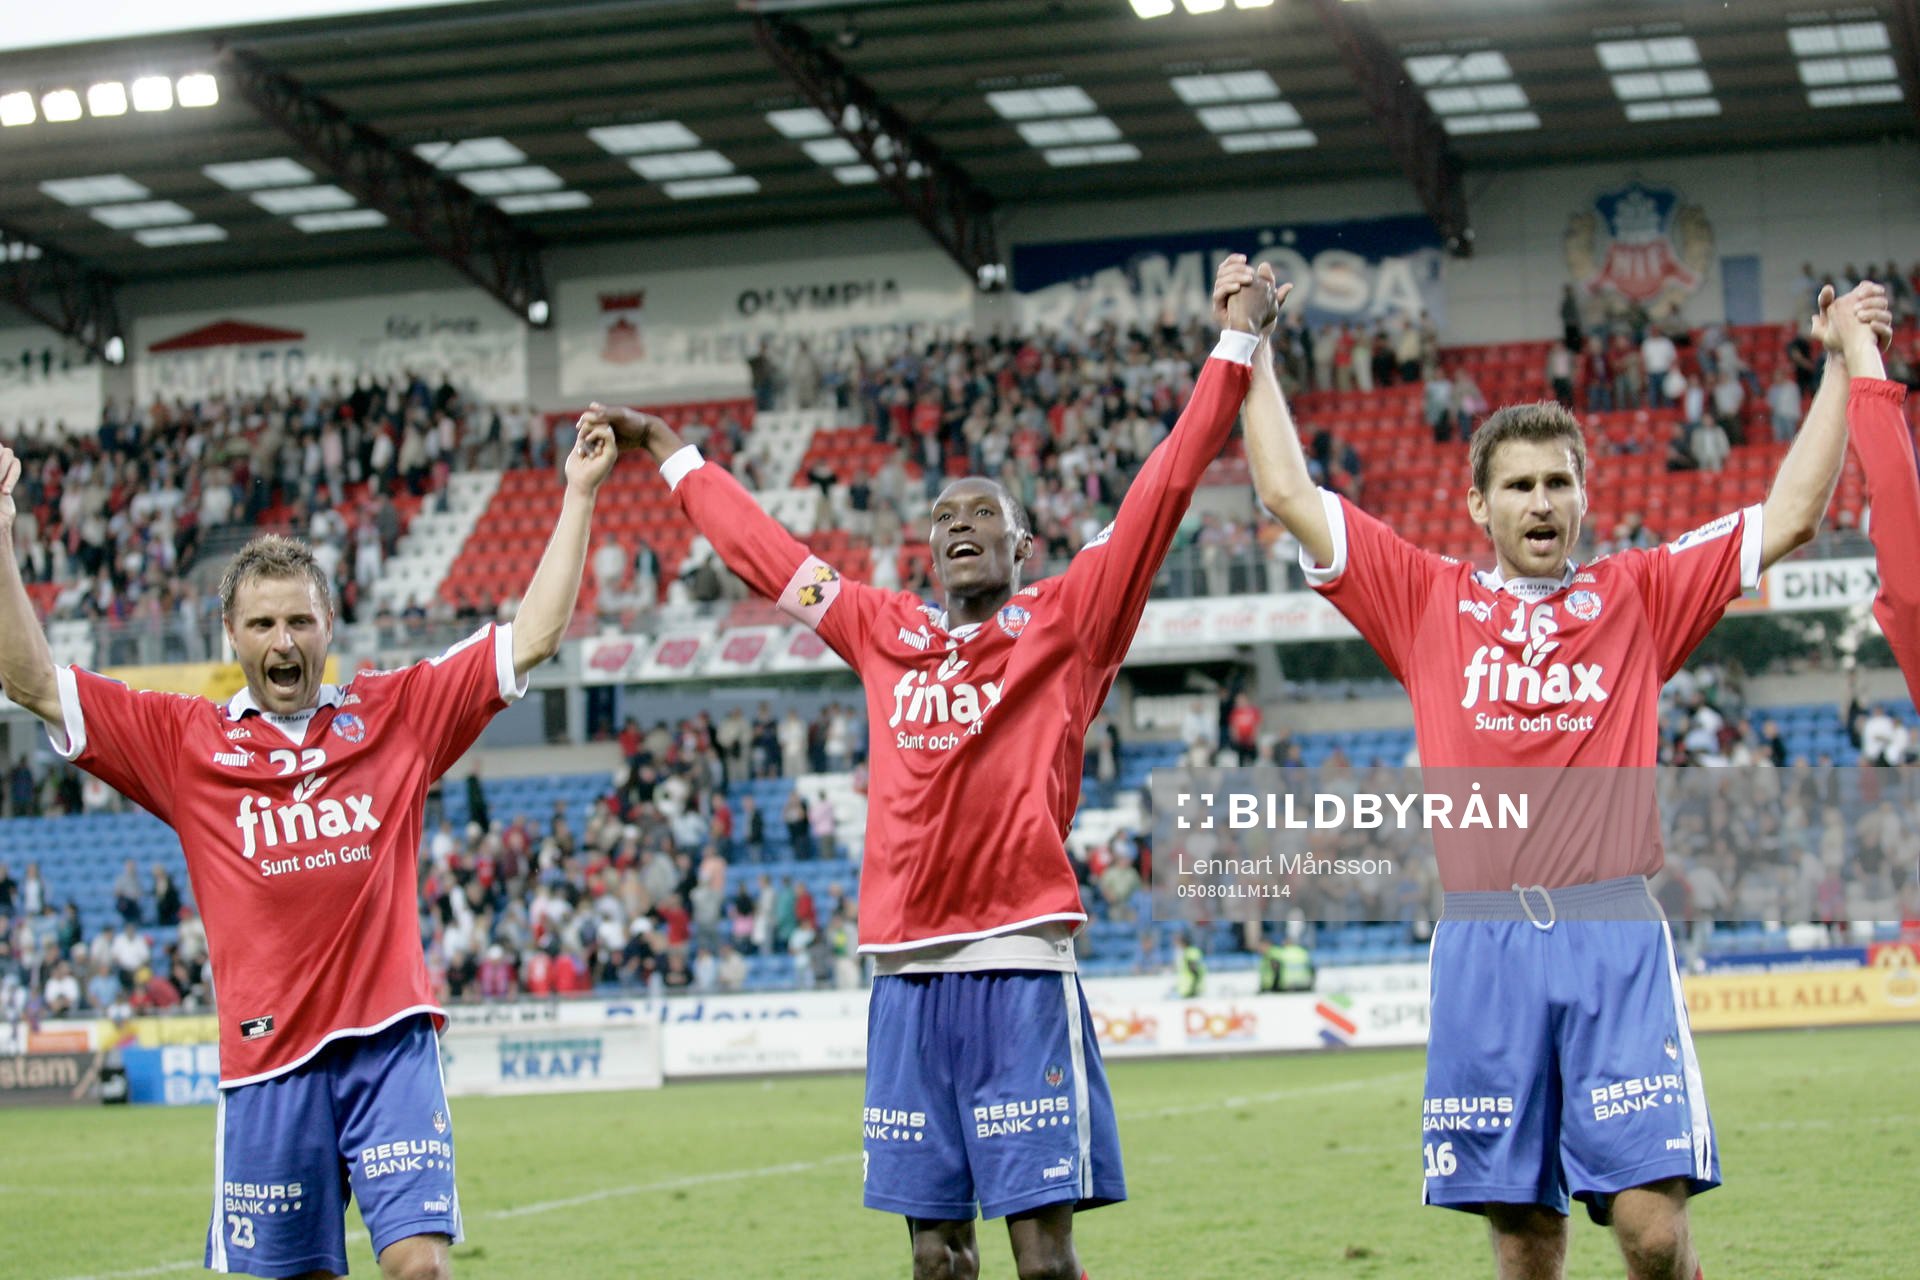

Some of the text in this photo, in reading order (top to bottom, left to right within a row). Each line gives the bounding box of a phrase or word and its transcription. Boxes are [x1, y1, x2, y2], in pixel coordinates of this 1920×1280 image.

[1501, 600, 1559, 643] 16
[898, 626, 927, 651] PUMA
[1460, 645, 1609, 709] finax
[1475, 712, 1594, 732] Sunt och Gott
[896, 731, 925, 750] Sunt
[213, 752, 248, 767] PUMA
[236, 793, 381, 859] finax
[261, 844, 371, 877] Sunt och Gott
[1718, 984, 1780, 1010] TILL
[1790, 982, 1868, 1008] ALLA
[500, 1054, 602, 1078] KRAFT
[974, 1096, 1069, 1122] RESURS
[1594, 1093, 1660, 1121] BANK
[976, 1117, 1033, 1138] BANK
[361, 1140, 451, 1163] RESURS
[1424, 1141, 1457, 1177] 16
[364, 1156, 423, 1180] BANK
[224, 1181, 302, 1199] RESURS
[225, 1197, 265, 1215] BANK
[227, 1214, 256, 1249] 23
